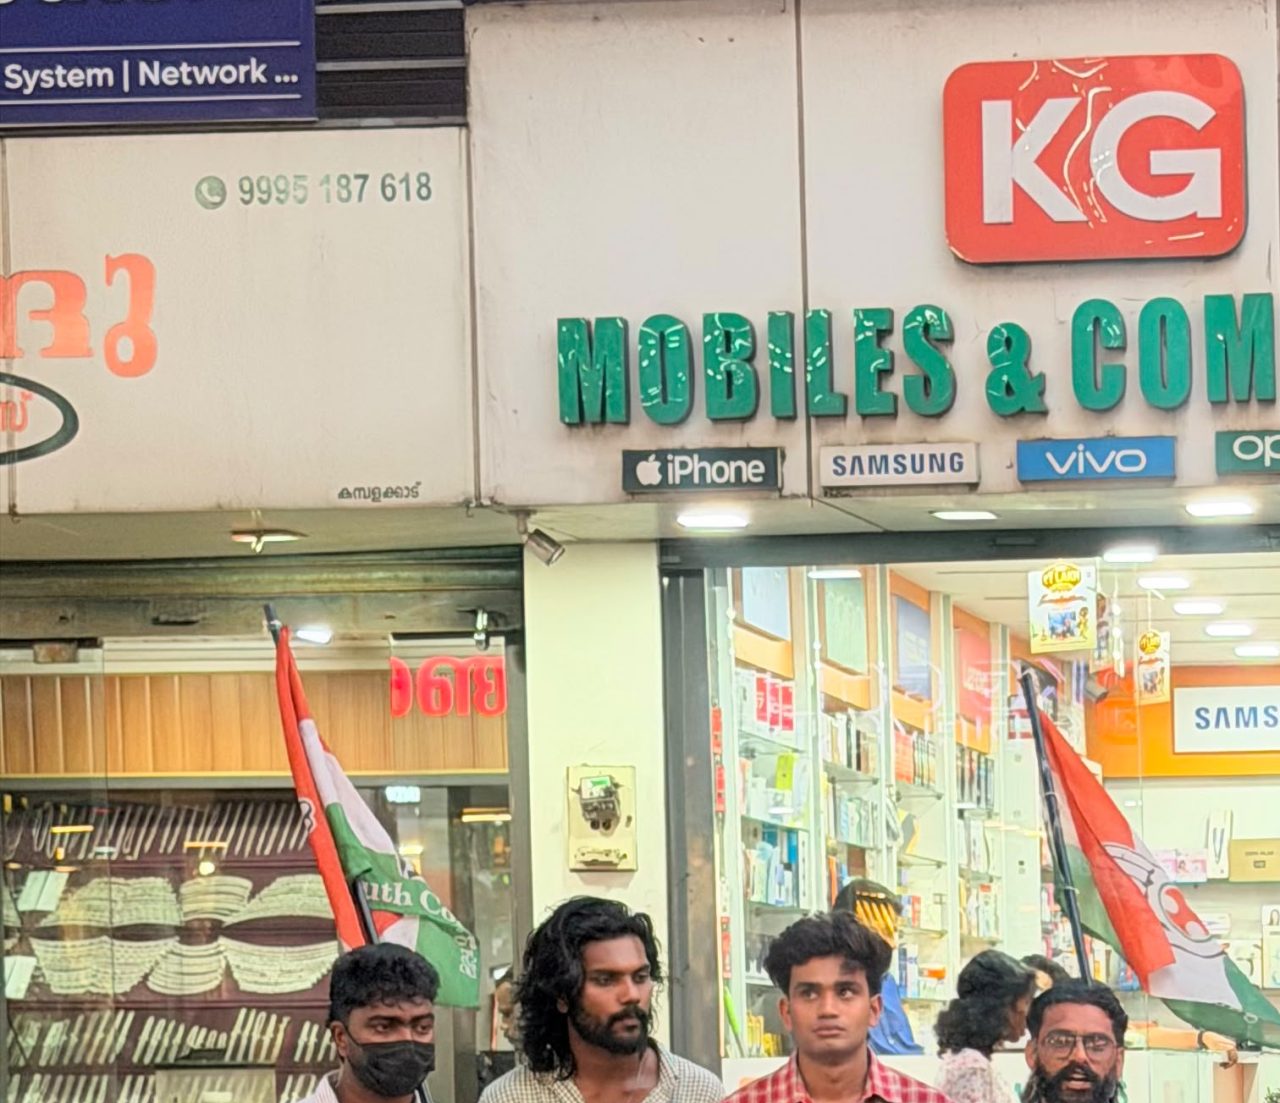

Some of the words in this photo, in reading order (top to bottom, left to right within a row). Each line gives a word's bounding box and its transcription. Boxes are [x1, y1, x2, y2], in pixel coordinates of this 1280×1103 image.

[5, 63, 114, 95] System
[139, 57, 267, 86] Network
[981, 90, 1222, 224] KG
[238, 175, 308, 205] 9995
[320, 173, 369, 203] 187
[381, 171, 432, 202] 618
[557, 304, 955, 426] MOBILES
[985, 322, 1047, 416] &
[667, 455, 765, 485] iPhone
[832, 452, 964, 477] SAMSUNG
[1045, 443, 1147, 475] vivo
